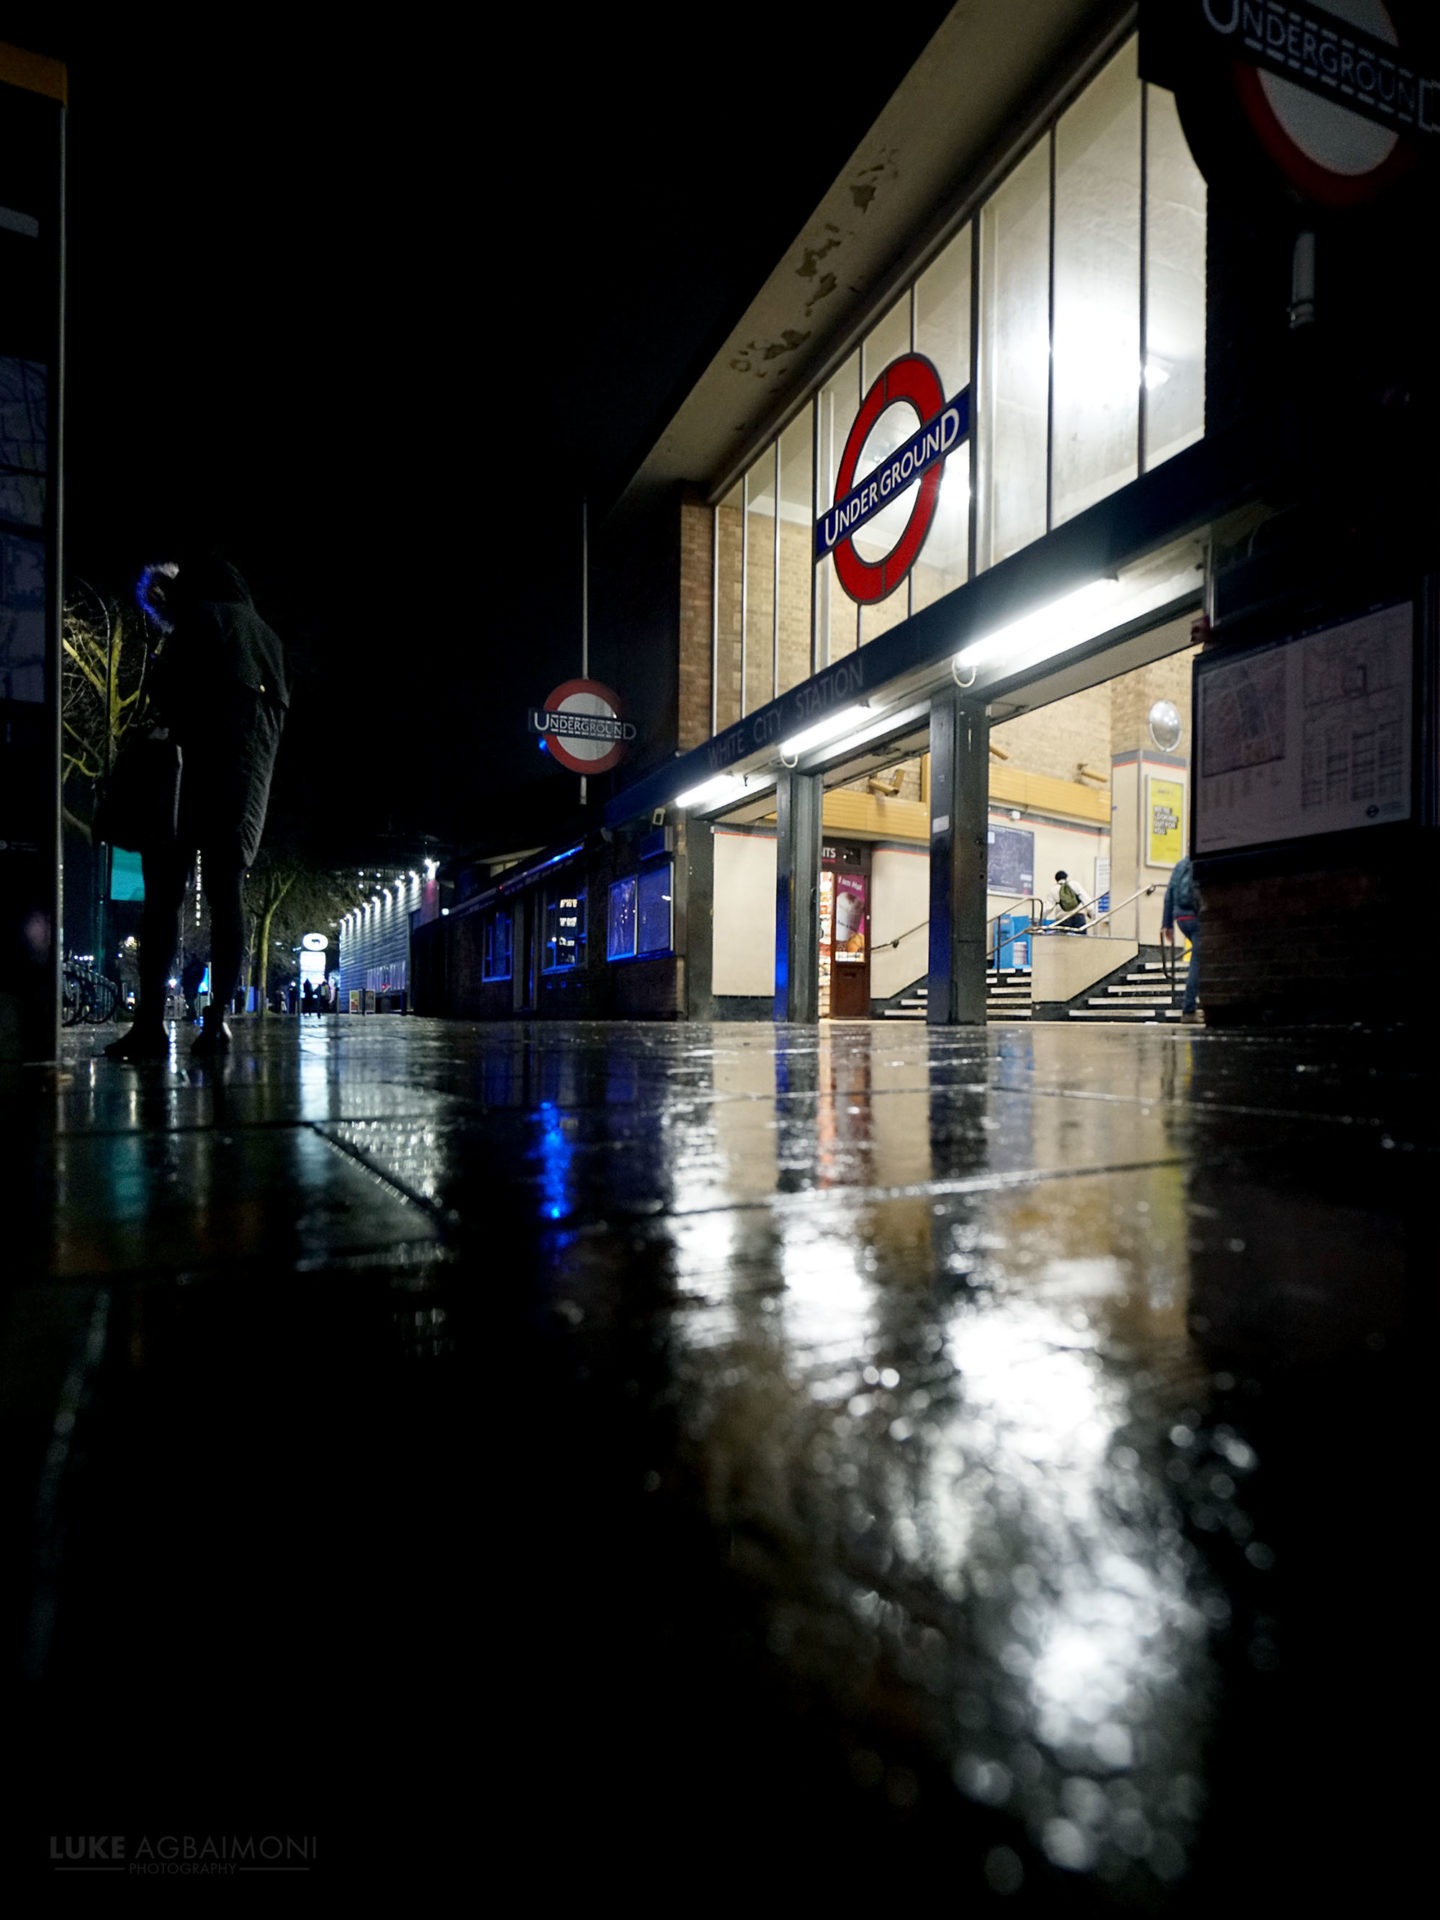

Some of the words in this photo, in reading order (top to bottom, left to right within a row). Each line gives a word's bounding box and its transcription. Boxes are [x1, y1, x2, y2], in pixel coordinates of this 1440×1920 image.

[534, 711, 637, 741] UNDERGROUND
[707, 728, 745, 769] WHITE
[753, 703, 784, 744] CITY
[795, 656, 864, 720] STATION
